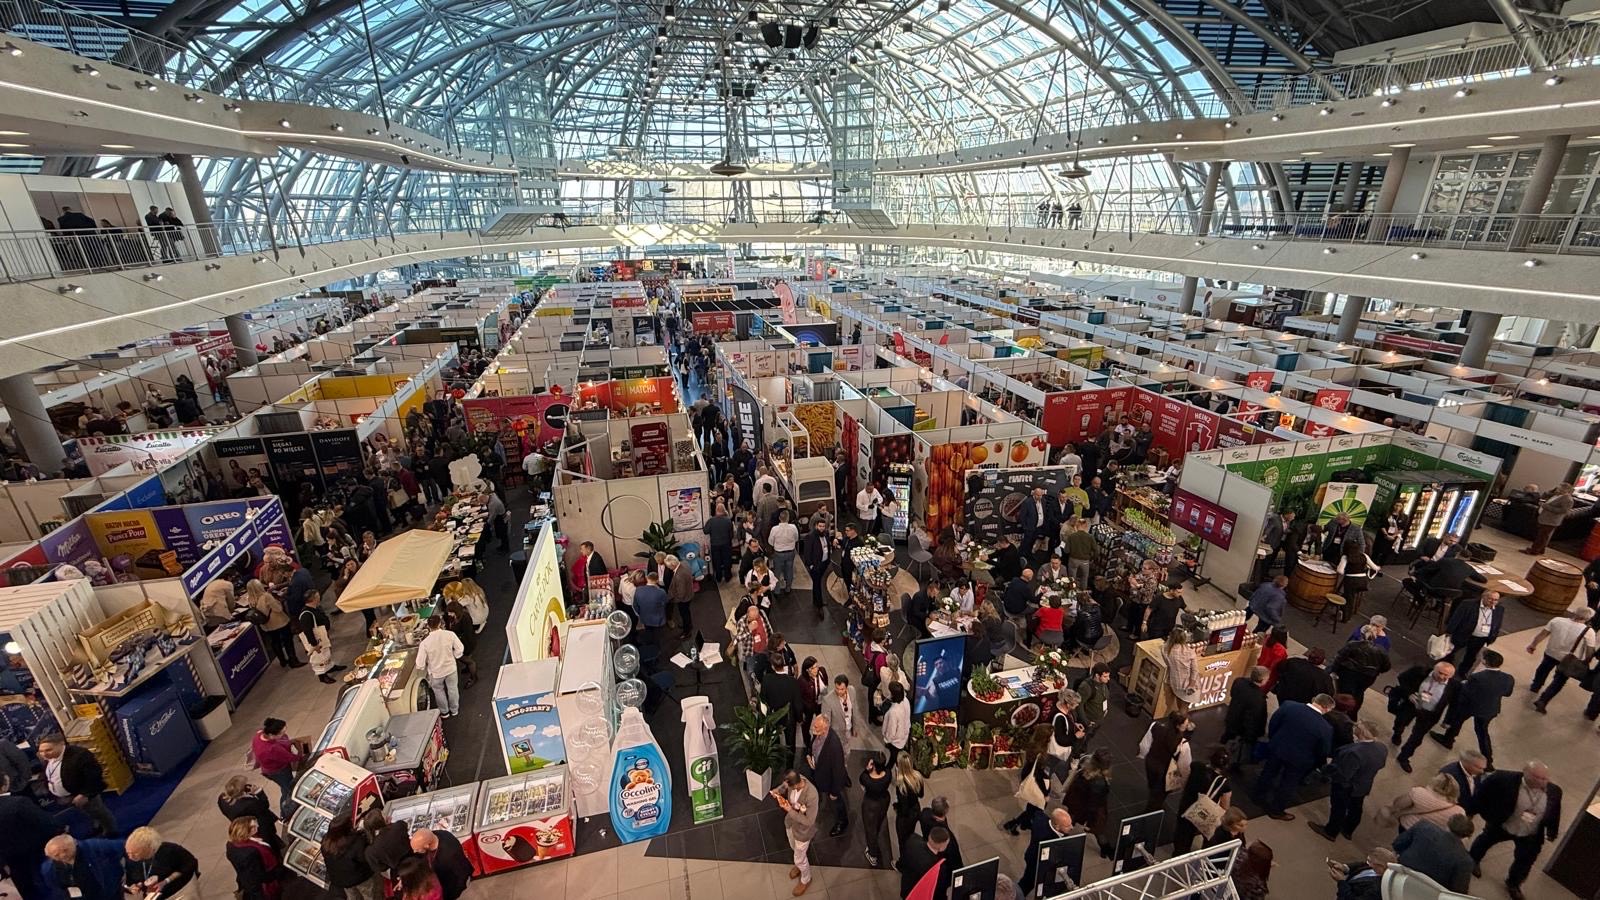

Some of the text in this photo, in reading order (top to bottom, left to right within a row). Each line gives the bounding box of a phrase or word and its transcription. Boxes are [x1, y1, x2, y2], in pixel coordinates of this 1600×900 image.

[630, 385, 656, 394] MATCHA
[1194, 412, 1212, 423] HEINZ
[1457, 451, 1482, 465] Carlsberg
[1291, 473, 1316, 484] OKOCIM
[1374, 476, 1397, 490] OKOCIM
[201, 511, 240, 524] OREO
[127, 529, 144, 538] POLO
[57, 533, 81, 557] Milka
[1200, 671, 1232, 694] UST
[695, 760, 713, 774] Cif
[621, 784, 661, 799] Coccolino
